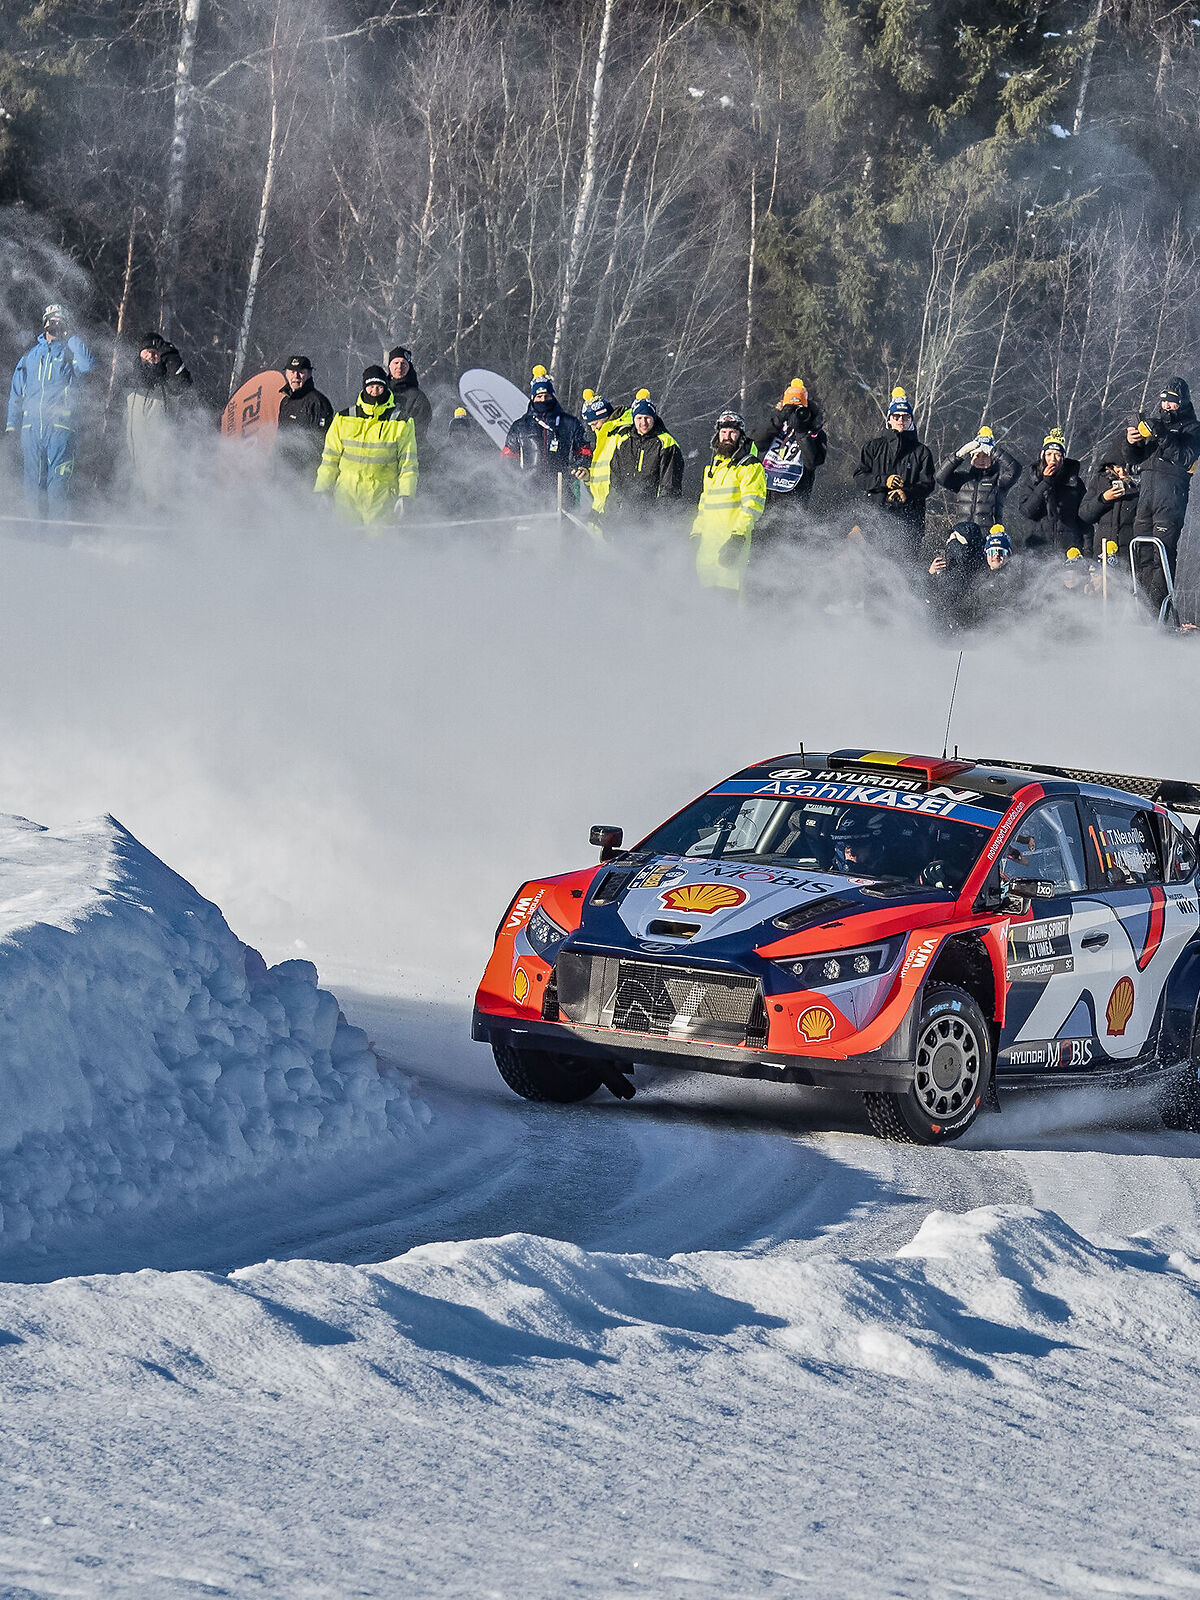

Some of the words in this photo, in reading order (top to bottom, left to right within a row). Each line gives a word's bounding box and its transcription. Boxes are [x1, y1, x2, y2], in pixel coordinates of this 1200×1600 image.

[815, 771, 922, 790] HYUNDAI
[753, 781, 959, 816] AsahiKASEI
[986, 801, 1026, 861] motorsport.hyundai.com
[1106, 828, 1146, 845] T.Neuville
[1088, 825, 1105, 874] 1
[702, 867, 835, 895] MOBIS
[1036, 881, 1052, 895] ixo
[506, 896, 534, 928] WIA
[1175, 897, 1199, 915] WIA
[1027, 924, 1048, 941] RACING
[1048, 920, 1066, 938] SPIRIT
[911, 938, 939, 968] WIA
[1008, 929, 1018, 962] 1
[1028, 943, 1037, 959] BY
[899, 949, 918, 979] HYUNDAI
[1020, 962, 1055, 978] SafetyCulture
[1009, 1049, 1046, 1065] HYUNDAI
[1044, 1039, 1093, 1069] MOBIS
